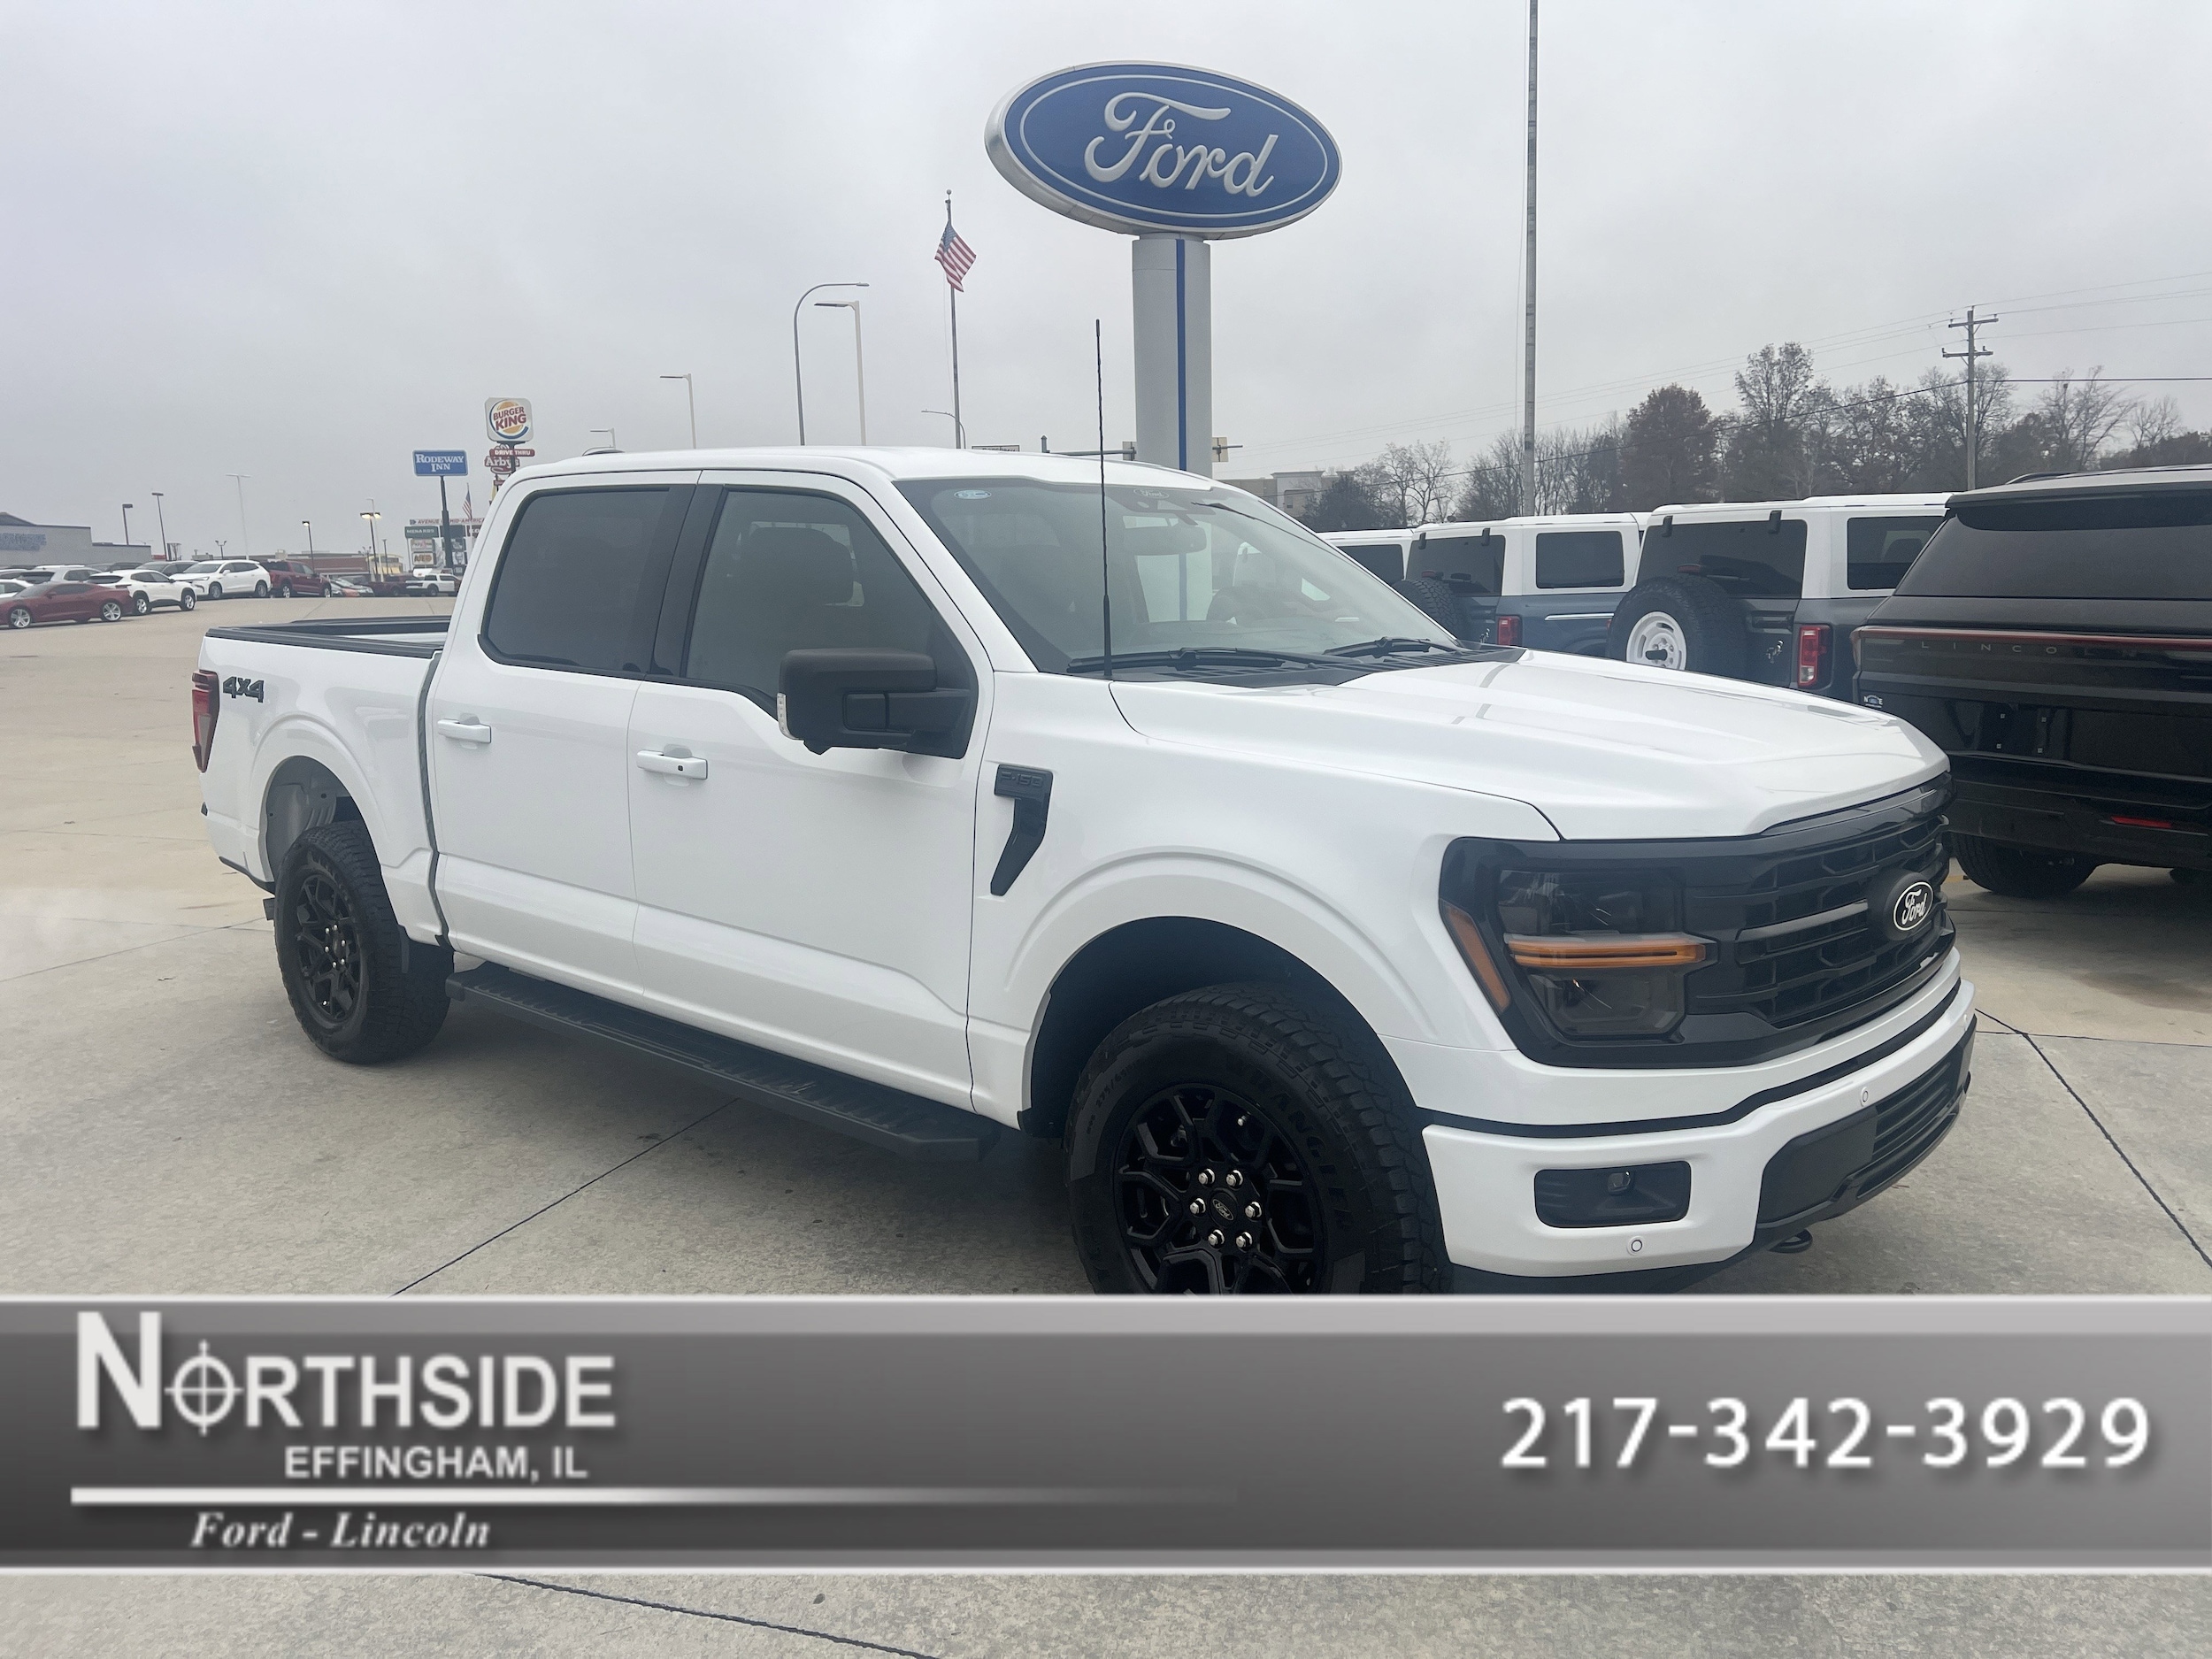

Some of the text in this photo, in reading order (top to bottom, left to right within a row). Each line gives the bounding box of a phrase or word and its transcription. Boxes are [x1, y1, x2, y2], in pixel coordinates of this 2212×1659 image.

[1084, 91, 1279, 197] Ford
[493, 406, 525, 421] BURGER
[495, 413, 527, 431] KING
[415, 454, 465, 464] RODEWAY
[486, 456, 519, 469] Arbys
[431, 463, 450, 472] INN
[1901, 889, 1927, 925] Ford
[1215, 1202, 1230, 1217] Ford
